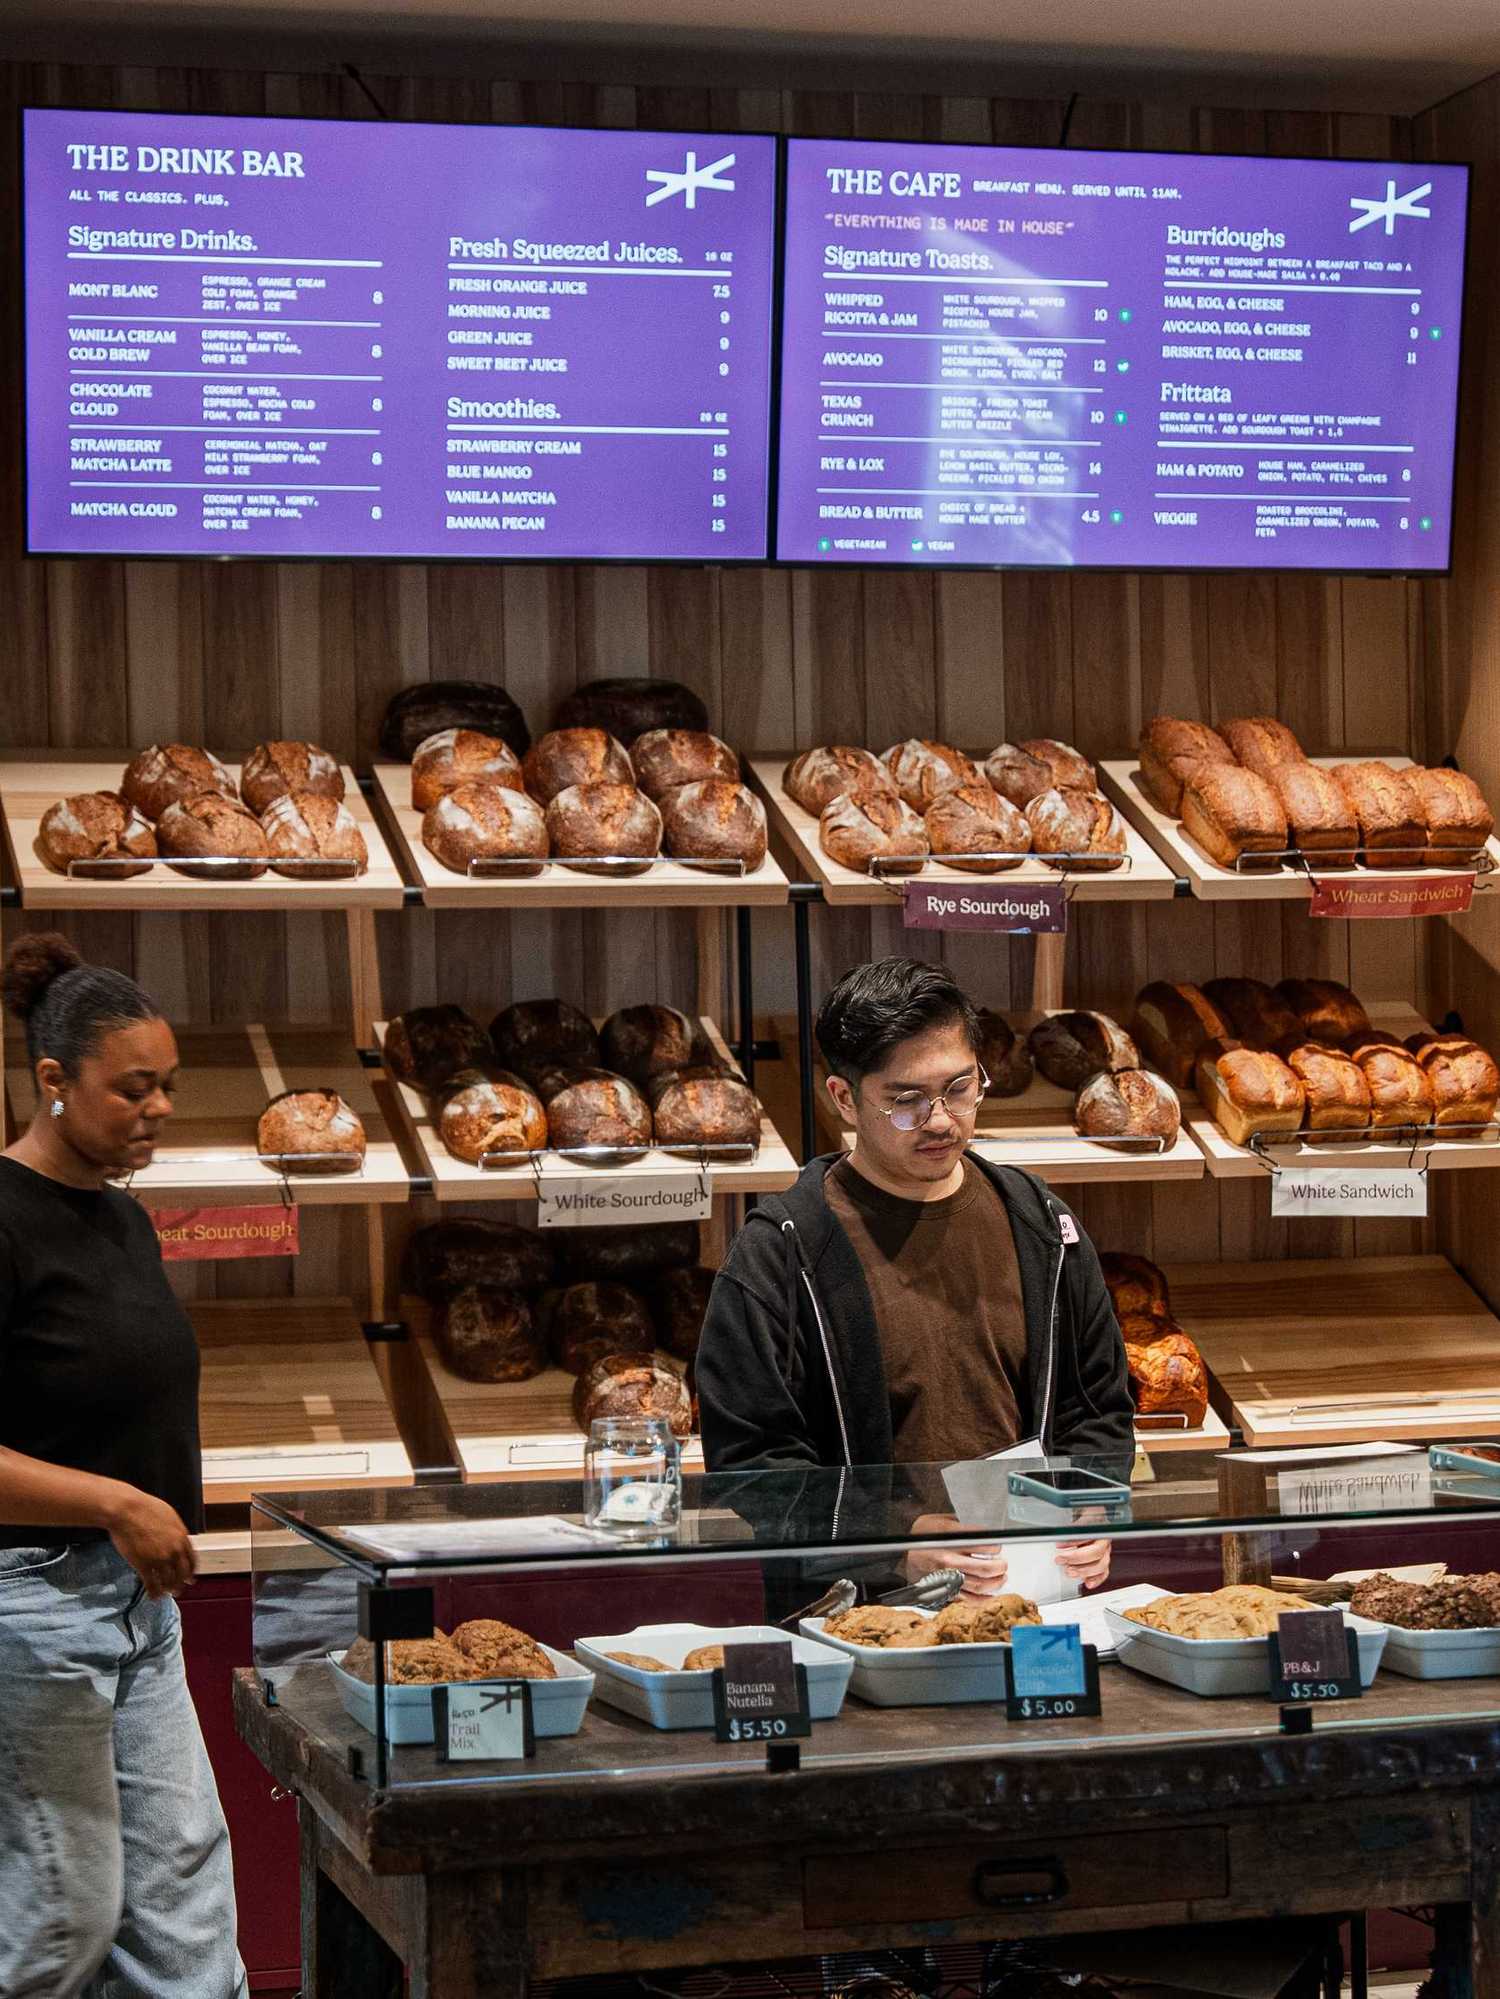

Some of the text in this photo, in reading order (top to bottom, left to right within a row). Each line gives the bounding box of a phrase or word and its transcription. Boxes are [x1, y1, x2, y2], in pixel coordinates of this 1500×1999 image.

[67, 144, 304, 177] THE DRINK BAR
[826, 168, 961, 197] THE CAFE
[973, 180, 1030, 193] BREAKFAST
[1072, 184, 1110, 196] SERVED
[1114, 185, 1146, 198] UNTIL
[69, 189, 91, 200] ALL
[97, 190, 118, 201] THE
[928, 217, 946, 231] IS
[955, 218, 988, 231] MADE
[998, 219, 1014, 233] IN
[68, 225, 257, 253] Signature Drinks.
[1167, 224, 1285, 252] Burridoughs
[449, 236, 682, 265] Fresh Squeezed Juices.
[824, 245, 993, 272] Signature Toasts.
[69, 283, 157, 298] MONT BLANC
[449, 278, 587, 294] FRESH ORANGE JUICE
[373, 291, 382, 303] 8
[825, 293, 883, 306] WHIPPED
[1164, 295, 1284, 311] HAM, EGG, & CHEESE
[448, 304, 550, 319] MORNING JUICE
[1095, 308, 1107, 321] 10
[1411, 302, 1419, 314] 9
[720, 311, 729, 323] 9
[825, 311, 917, 325] RICOTTA & JAM
[1162, 319, 1310, 336] AVOCADO, EGG, & CHEESE
[1410, 327, 1418, 338] 9
[68, 328, 176, 343] VANILLA CREAM
[448, 330, 532, 345] GREEN JUICE
[720, 337, 729, 349] 9
[68, 347, 149, 361] COLD BREW
[371, 345, 381, 357] 8
[1162, 345, 1302, 361] BRISKET, EGG, & CHEESE
[1407, 352, 1416, 363] 11
[447, 356, 567, 371] SWEET BEET JUICE
[823, 352, 883, 366] AVOCADO
[1094, 359, 1105, 371] 12
[719, 363, 728, 375] 9
[70, 383, 152, 397] CHOCOLATE
[1161, 382, 1232, 402] Frittata
[70, 402, 118, 415] CLOUD
[372, 398, 382, 411] 8
[447, 396, 560, 419] Smoothies.
[821, 395, 861, 408] TEXAS
[821, 413, 873, 426] CRUNCH
[1091, 410, 1104, 423] 10
[70, 438, 161, 452] STRAWBERRY
[446, 439, 581, 454] STRAWBERRY CREAM
[714, 444, 726, 456] 15
[71, 457, 171, 471] MATCHA LATTE
[372, 452, 381, 464] 8
[821, 457, 884, 470] RYE & LOX
[447, 465, 532, 479] BLUE MANGO
[713, 468, 726, 480] 15
[1089, 462, 1101, 474] 14
[1156, 463, 1243, 477] HAM & POTATO
[1402, 469, 1410, 481] 8
[445, 490, 556, 504] VANILLA MATCHA
[712, 494, 725, 506] 15
[71, 502, 177, 516] MATCHA CLOUD
[371, 506, 381, 519] 8
[819, 505, 922, 519] BREAD & BUTTER
[1081, 510, 1100, 522] 4.5
[446, 516, 544, 529] BANANA PECAN
[712, 519, 725, 531] 15
[1153, 512, 1197, 524] VEGGIE
[1400, 517, 1408, 529] 8
[834, 539, 886, 549] VEGETARIAN
[927, 541, 954, 550] VEGAN
[1331, 884, 1463, 903] Wheat Sandwich
[927, 896, 1050, 920] Rye Sourdough
[555, 1188, 705, 1209] White Sourdough
[1291, 1184, 1414, 1199] White Sandwich
[194, 1221, 292, 1242] Sourdough
[726, 1682, 775, 1694] Banana
[1290, 1682, 1339, 1698] $5.50
[727, 1694, 773, 1708] Nutella
[1021, 1698, 1075, 1717] $5.00
[450, 1723, 480, 1736] Trail
[728, 1718, 787, 1741] $5.50
